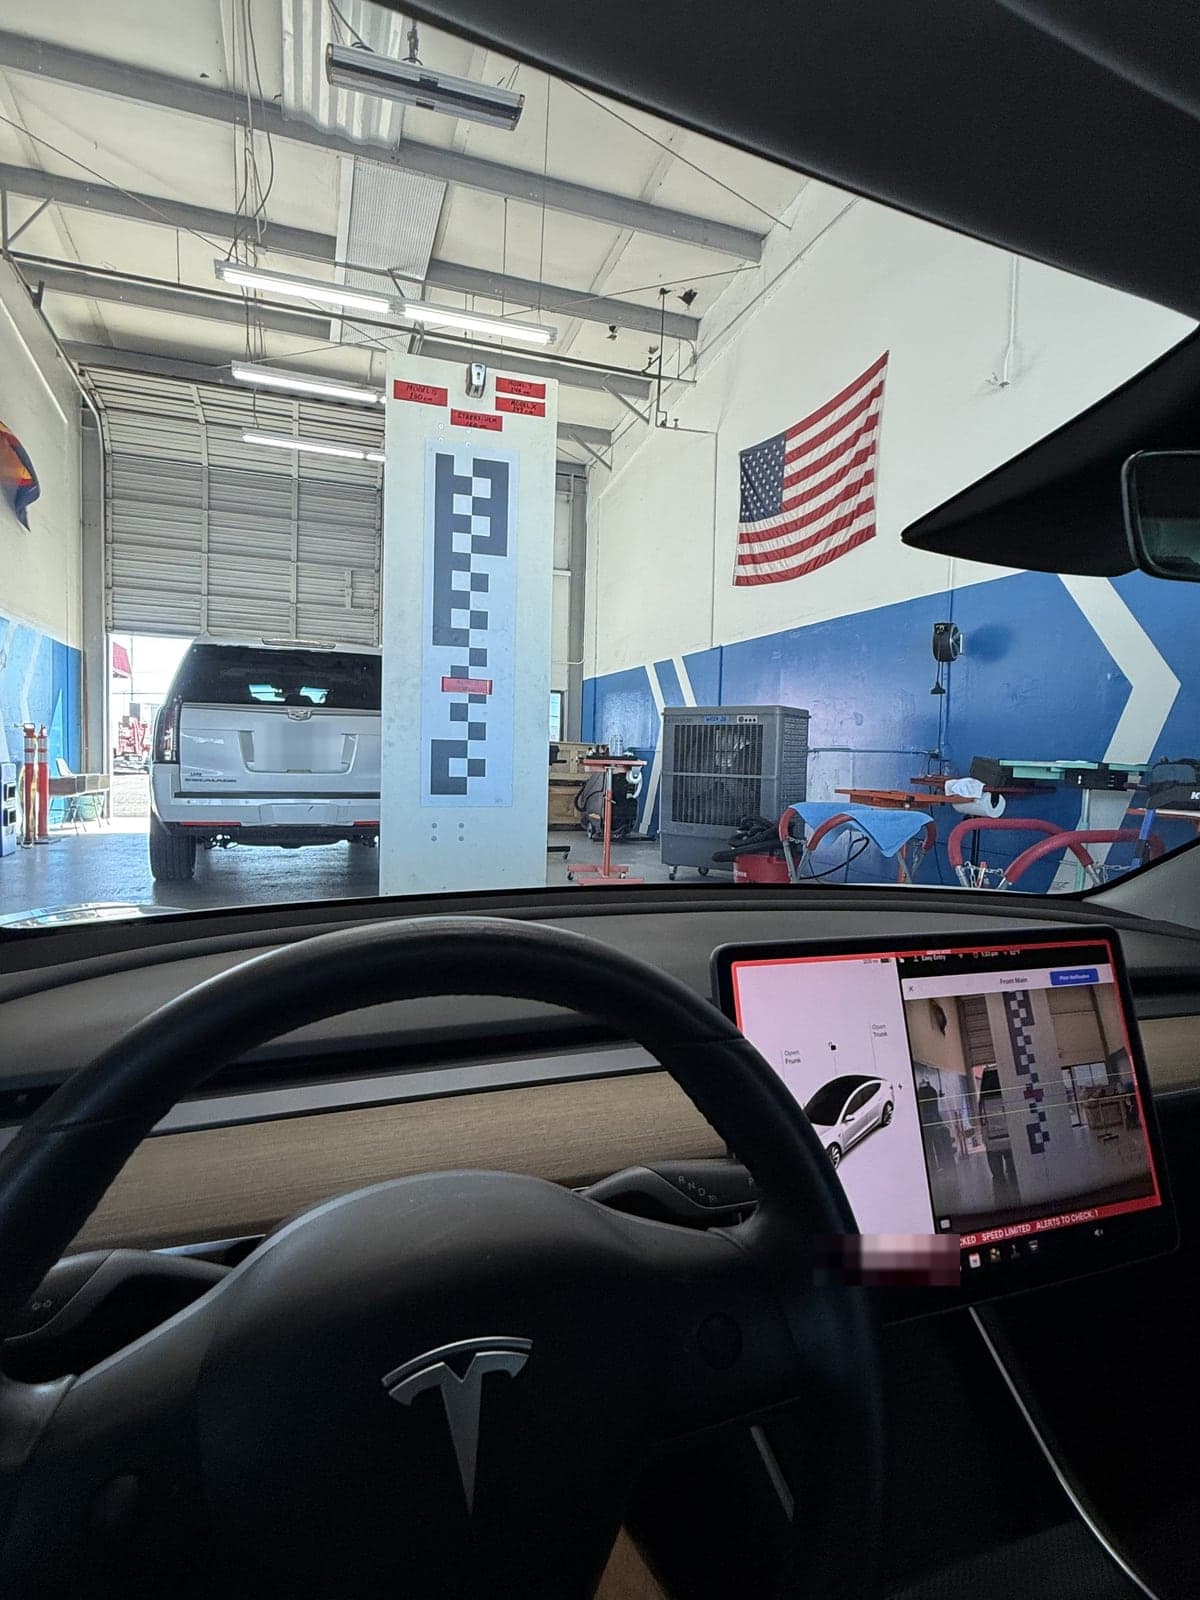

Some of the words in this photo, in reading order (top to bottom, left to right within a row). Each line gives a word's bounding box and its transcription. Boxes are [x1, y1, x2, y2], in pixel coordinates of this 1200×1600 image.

[1000, 977, 1014, 985] Front
[981, 1229, 1004, 1242] SPEED
[1004, 1224, 1031, 1238] LIMITED
[1036, 1217, 1061, 1230] ALERTS
[1061, 1215, 1071, 1225] TO
